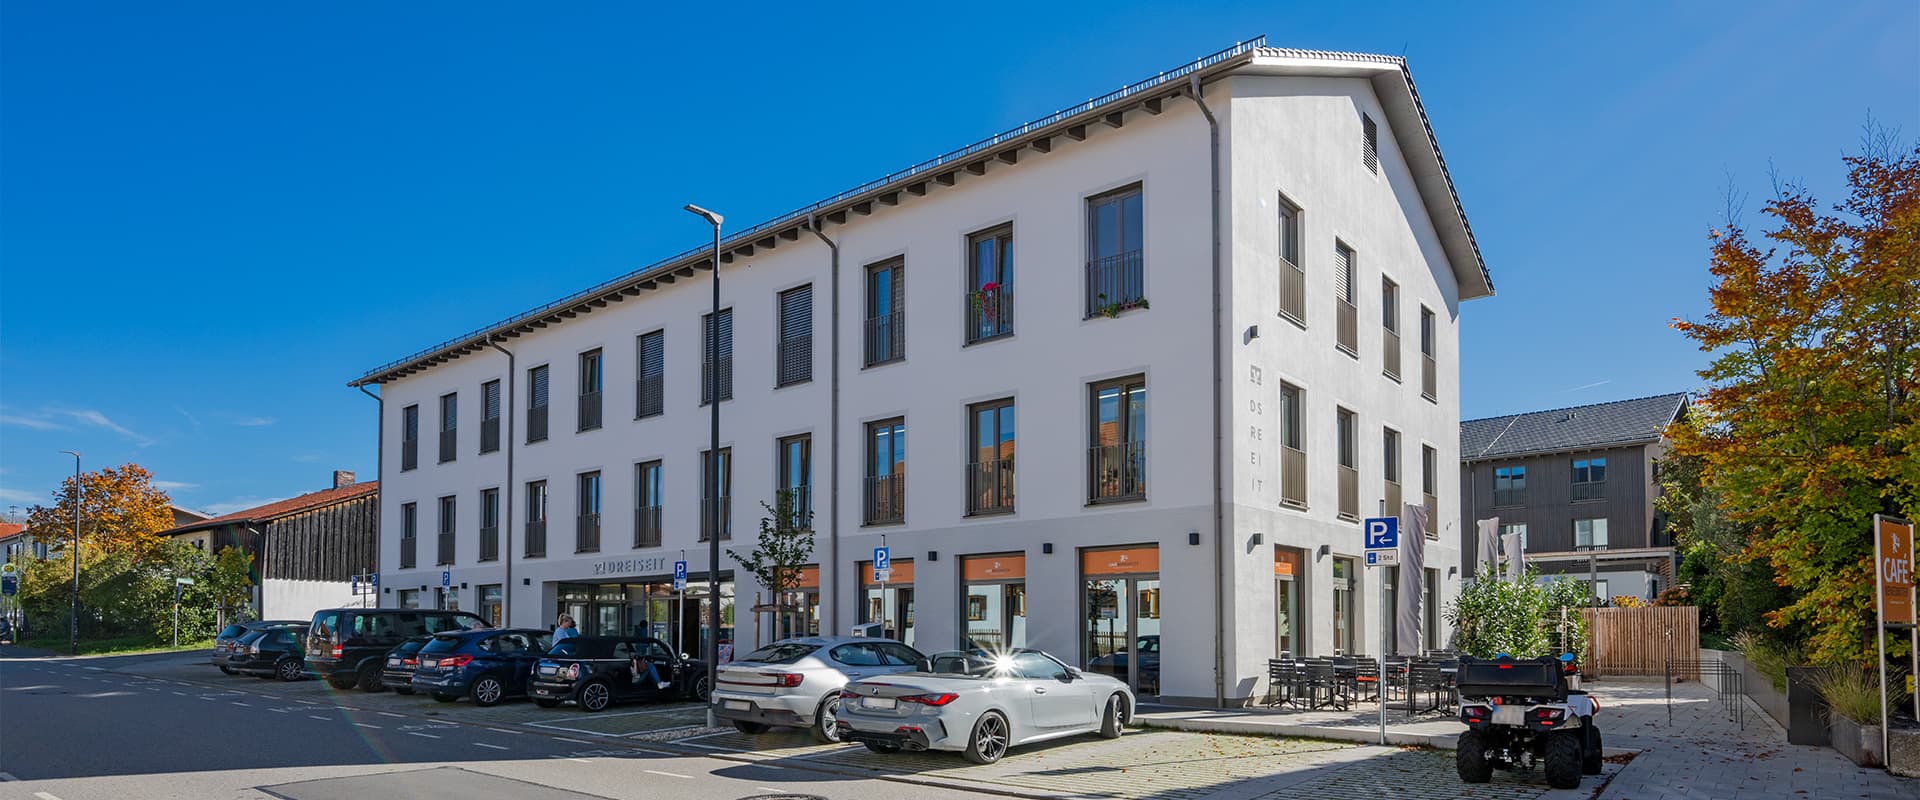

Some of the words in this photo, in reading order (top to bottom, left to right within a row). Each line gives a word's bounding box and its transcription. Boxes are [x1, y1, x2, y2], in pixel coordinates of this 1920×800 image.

[1370, 521, 1388, 545] P
[608, 558, 665, 573] DREISEIT
[877, 550, 886, 567] P
[676, 563, 684, 578] P
[1883, 553, 1908, 584] CAFÉ
